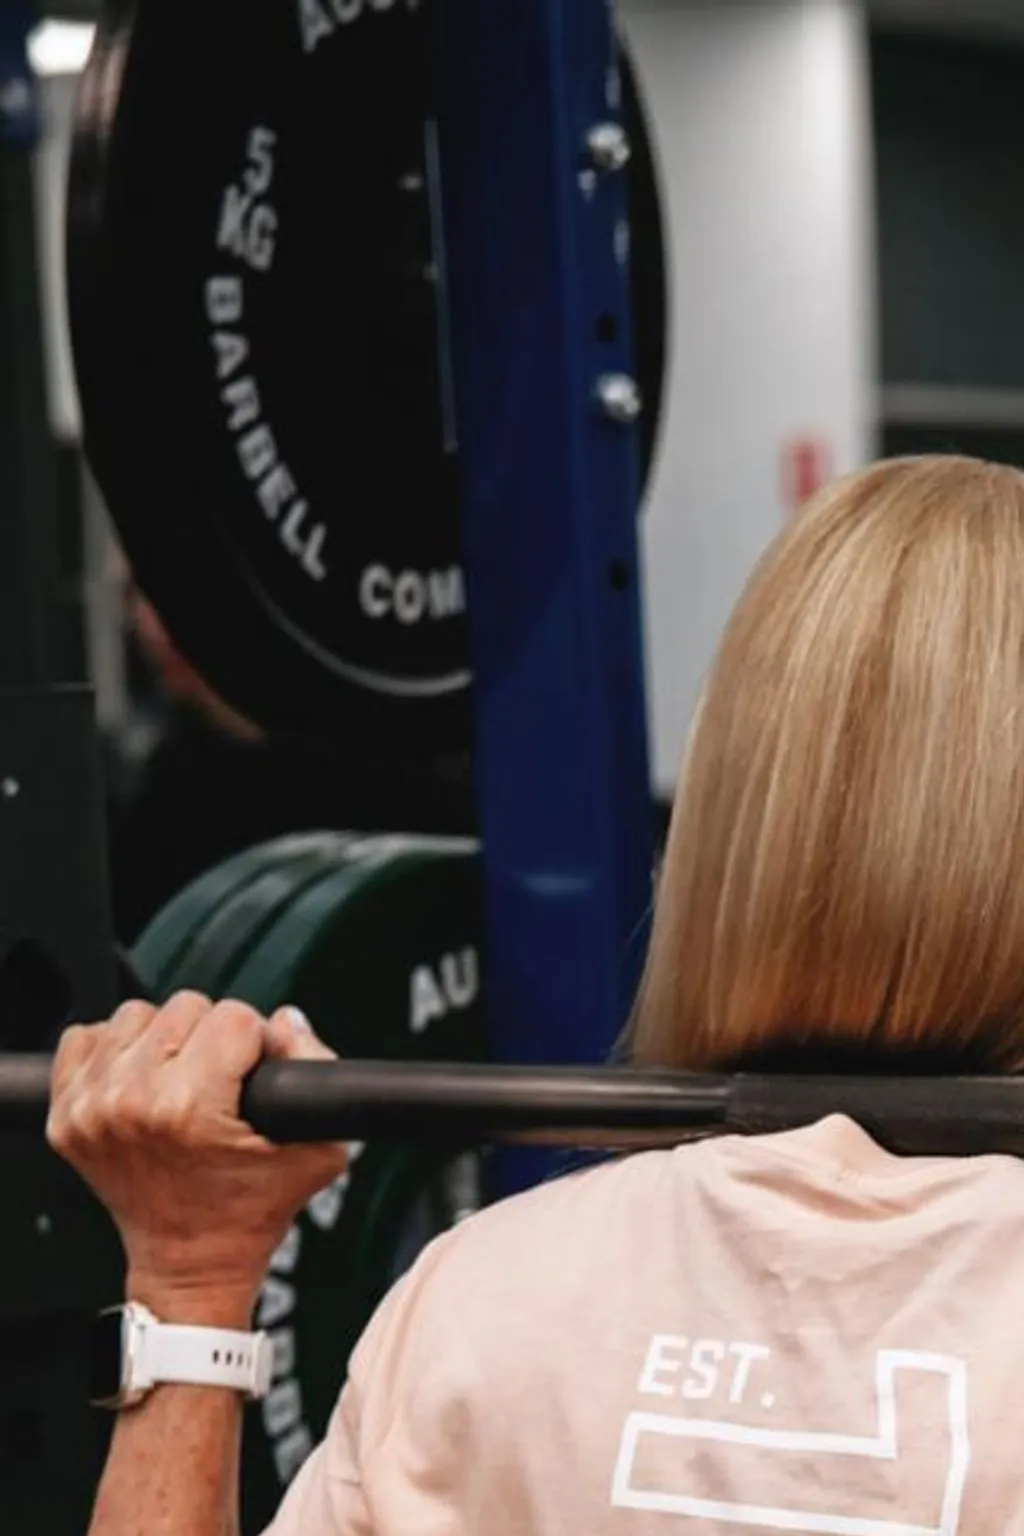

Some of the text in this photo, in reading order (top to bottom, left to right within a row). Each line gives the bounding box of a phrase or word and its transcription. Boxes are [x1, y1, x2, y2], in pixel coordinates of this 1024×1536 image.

[243, 124, 278, 196] 5
[216, 184, 279, 272] KG
[205, 275, 328, 582] BARBELL
[637, 1333, 776, 1409] EST.
